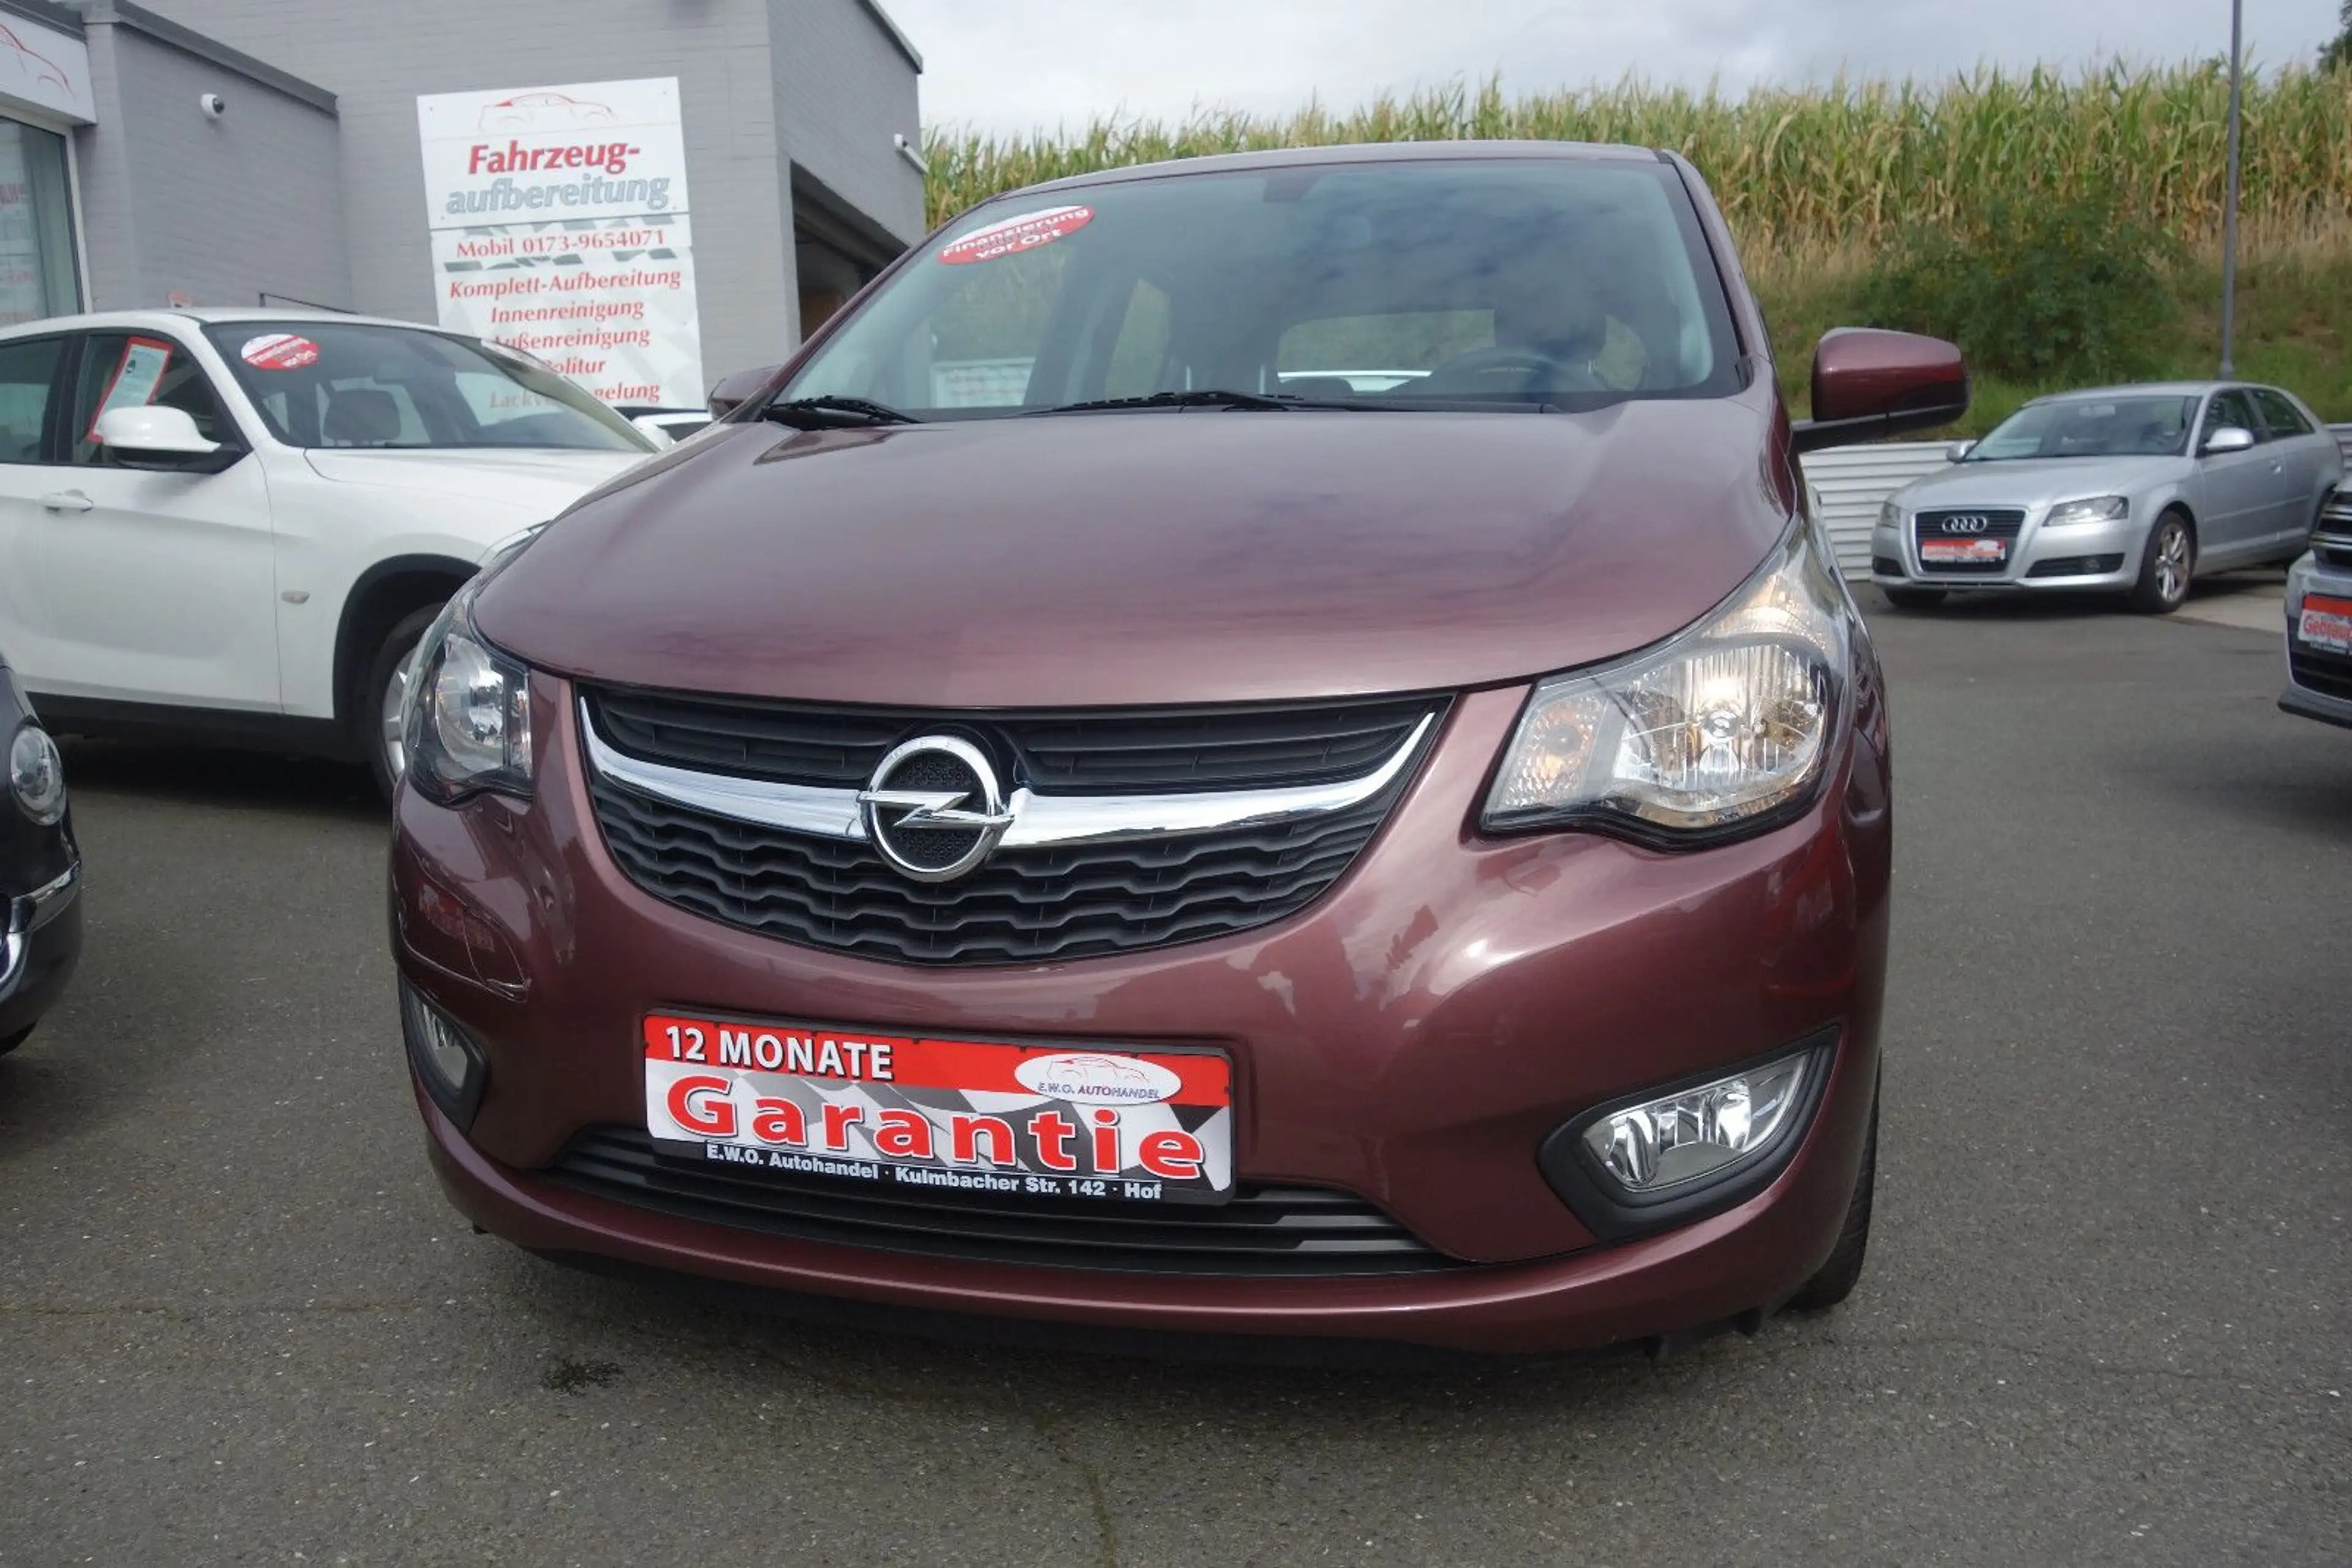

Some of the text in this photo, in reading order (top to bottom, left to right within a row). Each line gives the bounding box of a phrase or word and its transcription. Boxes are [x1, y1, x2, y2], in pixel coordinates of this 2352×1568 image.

[468, 140, 641, 175] Fahrzeug-
[447, 173, 670, 214] aufbereitung
[457, 229, 665, 257] Mobil 0173-9654071
[976, 229, 1061, 259] vor Ort
[450, 270, 682, 300] Komplett-Aufbereitung
[491, 300, 644, 323] Innenreinigung
[666, 1026, 894, 1081] 12 MONATE
[1038, 1082, 1159, 1099] E.W.O. AUTOHANDEL
[666, 1074, 1204, 1179] Garantie
[706, 1143, 1163, 1199] E.W.O. Autohandel Kulmbacher Str. 142 Hof
